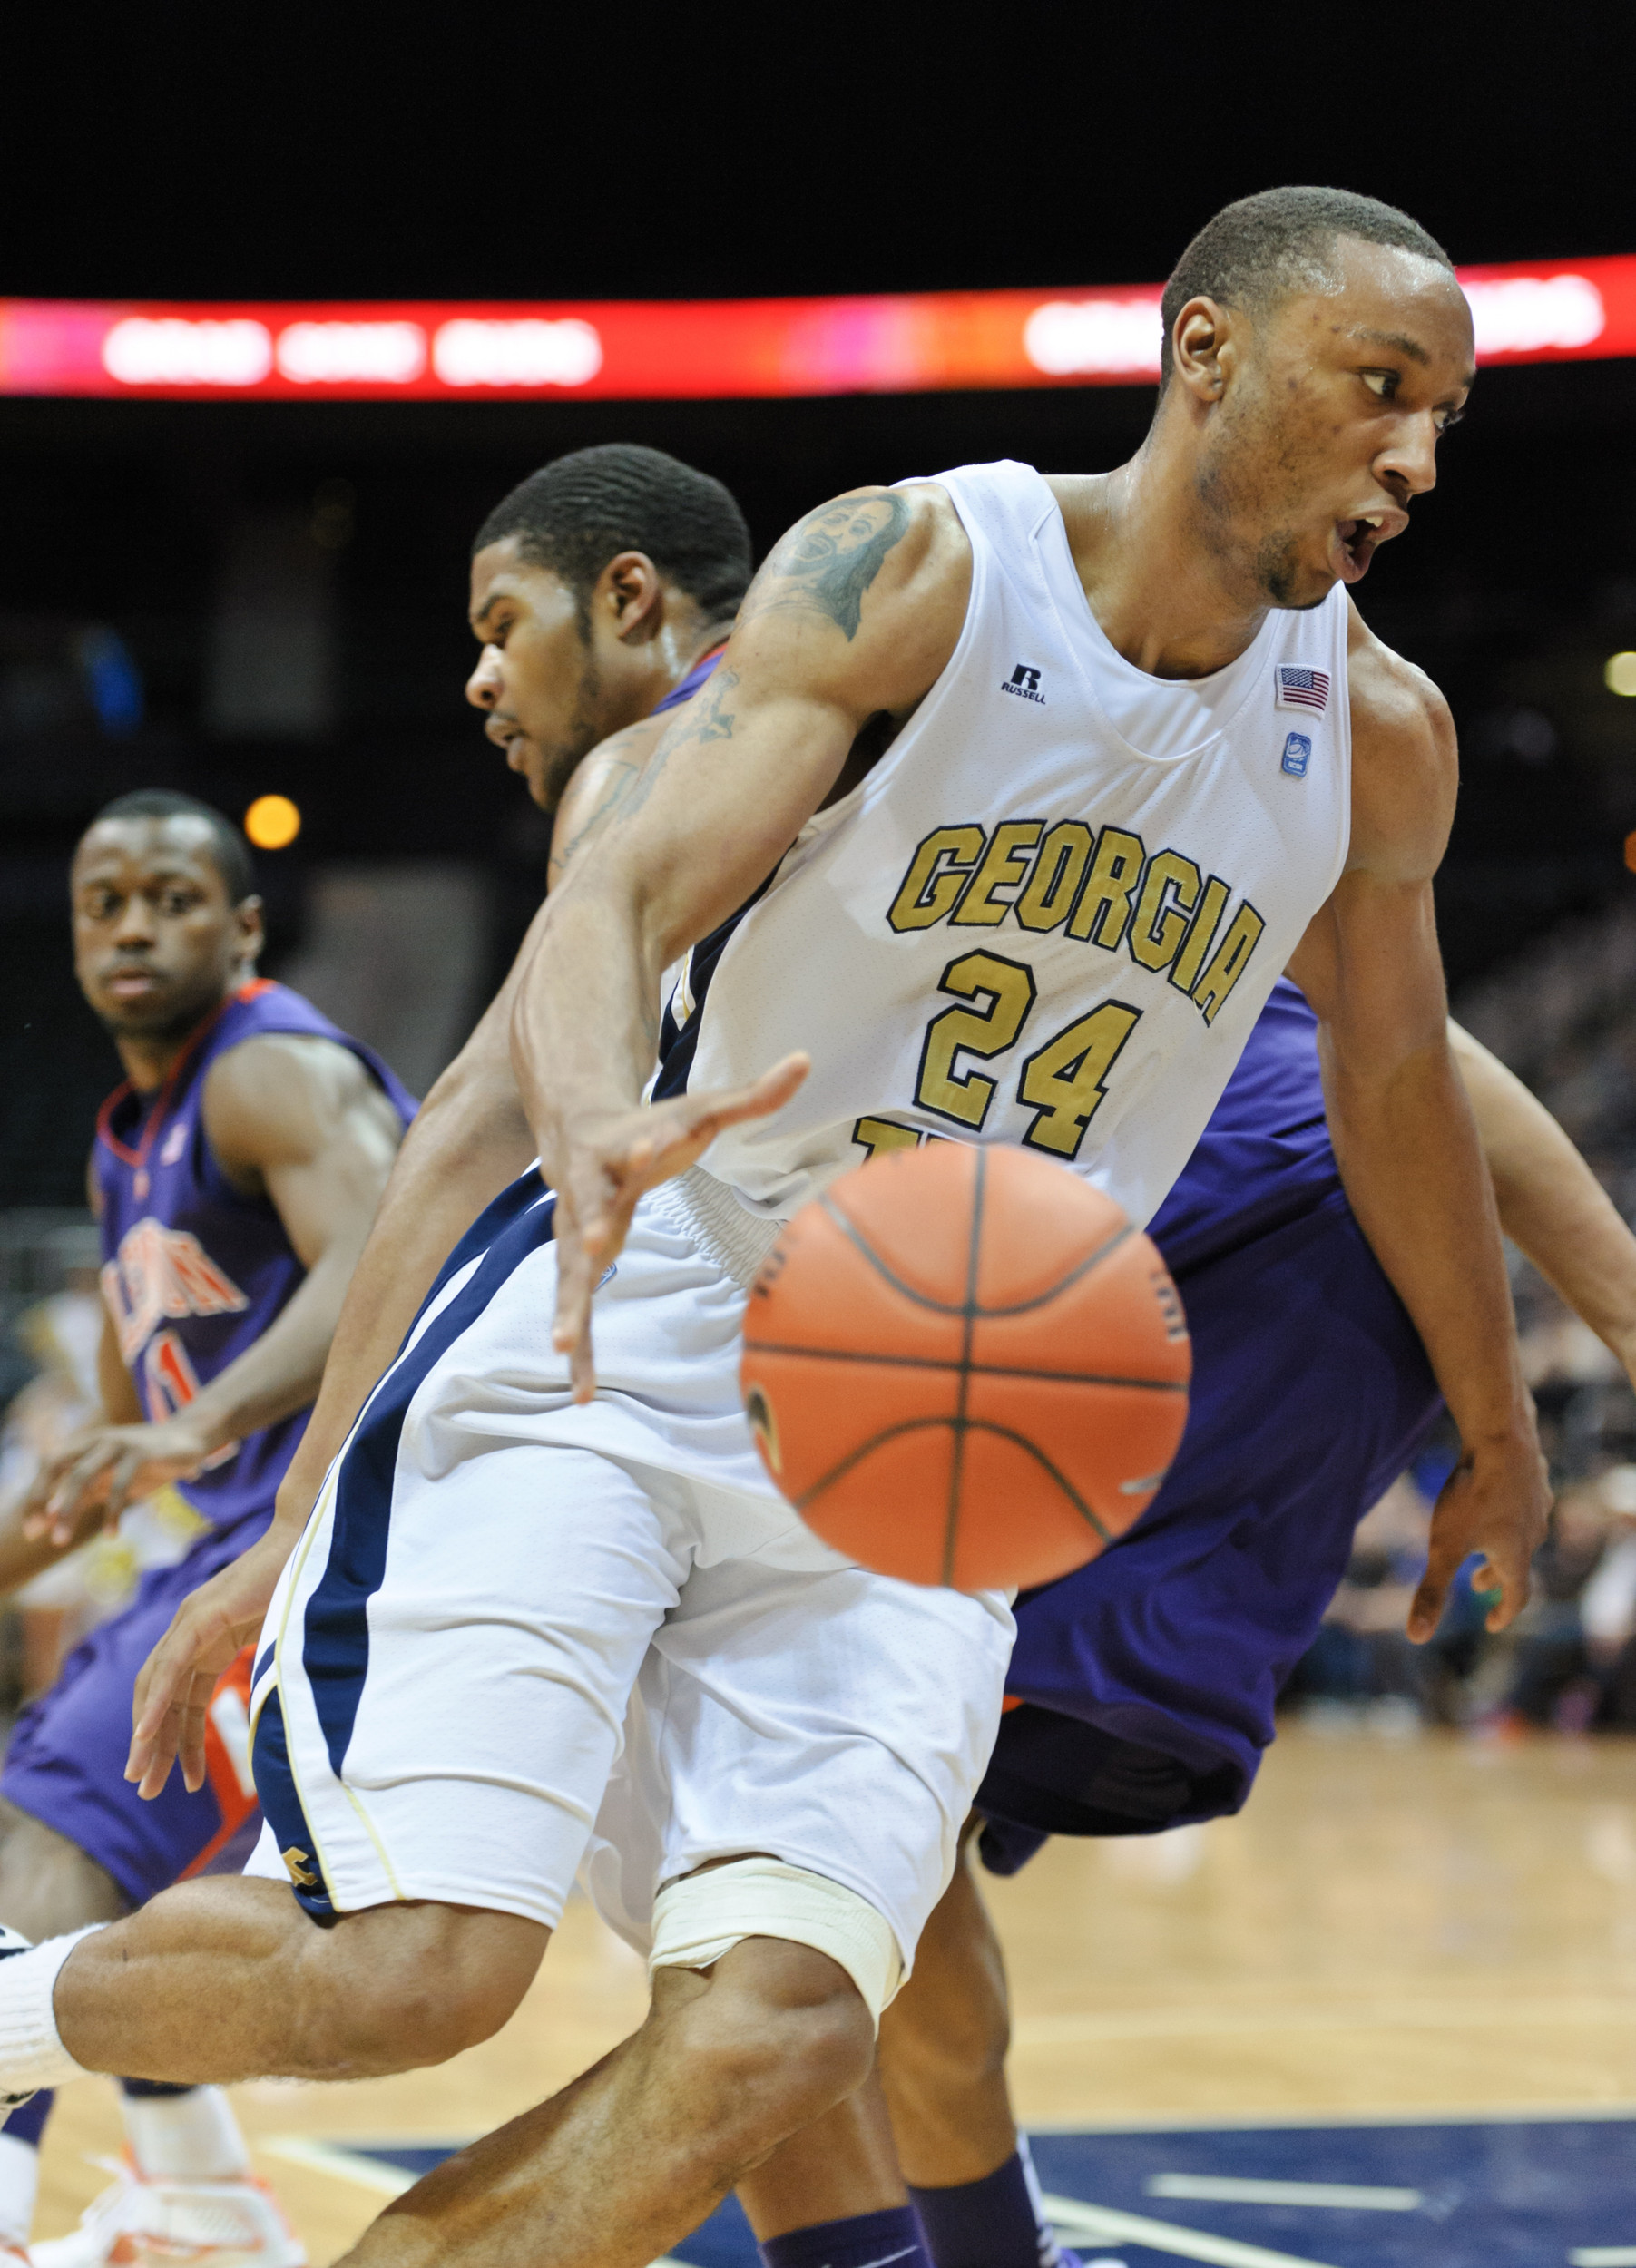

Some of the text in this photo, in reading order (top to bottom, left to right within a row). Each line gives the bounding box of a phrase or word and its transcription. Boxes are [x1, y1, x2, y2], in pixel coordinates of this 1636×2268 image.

[1001, 682, 1046, 705] RUSSELL
[1011, 663, 1041, 690] R
[886, 819, 1266, 1028] GEORGIA
[912, 948, 1144, 1161] 24
